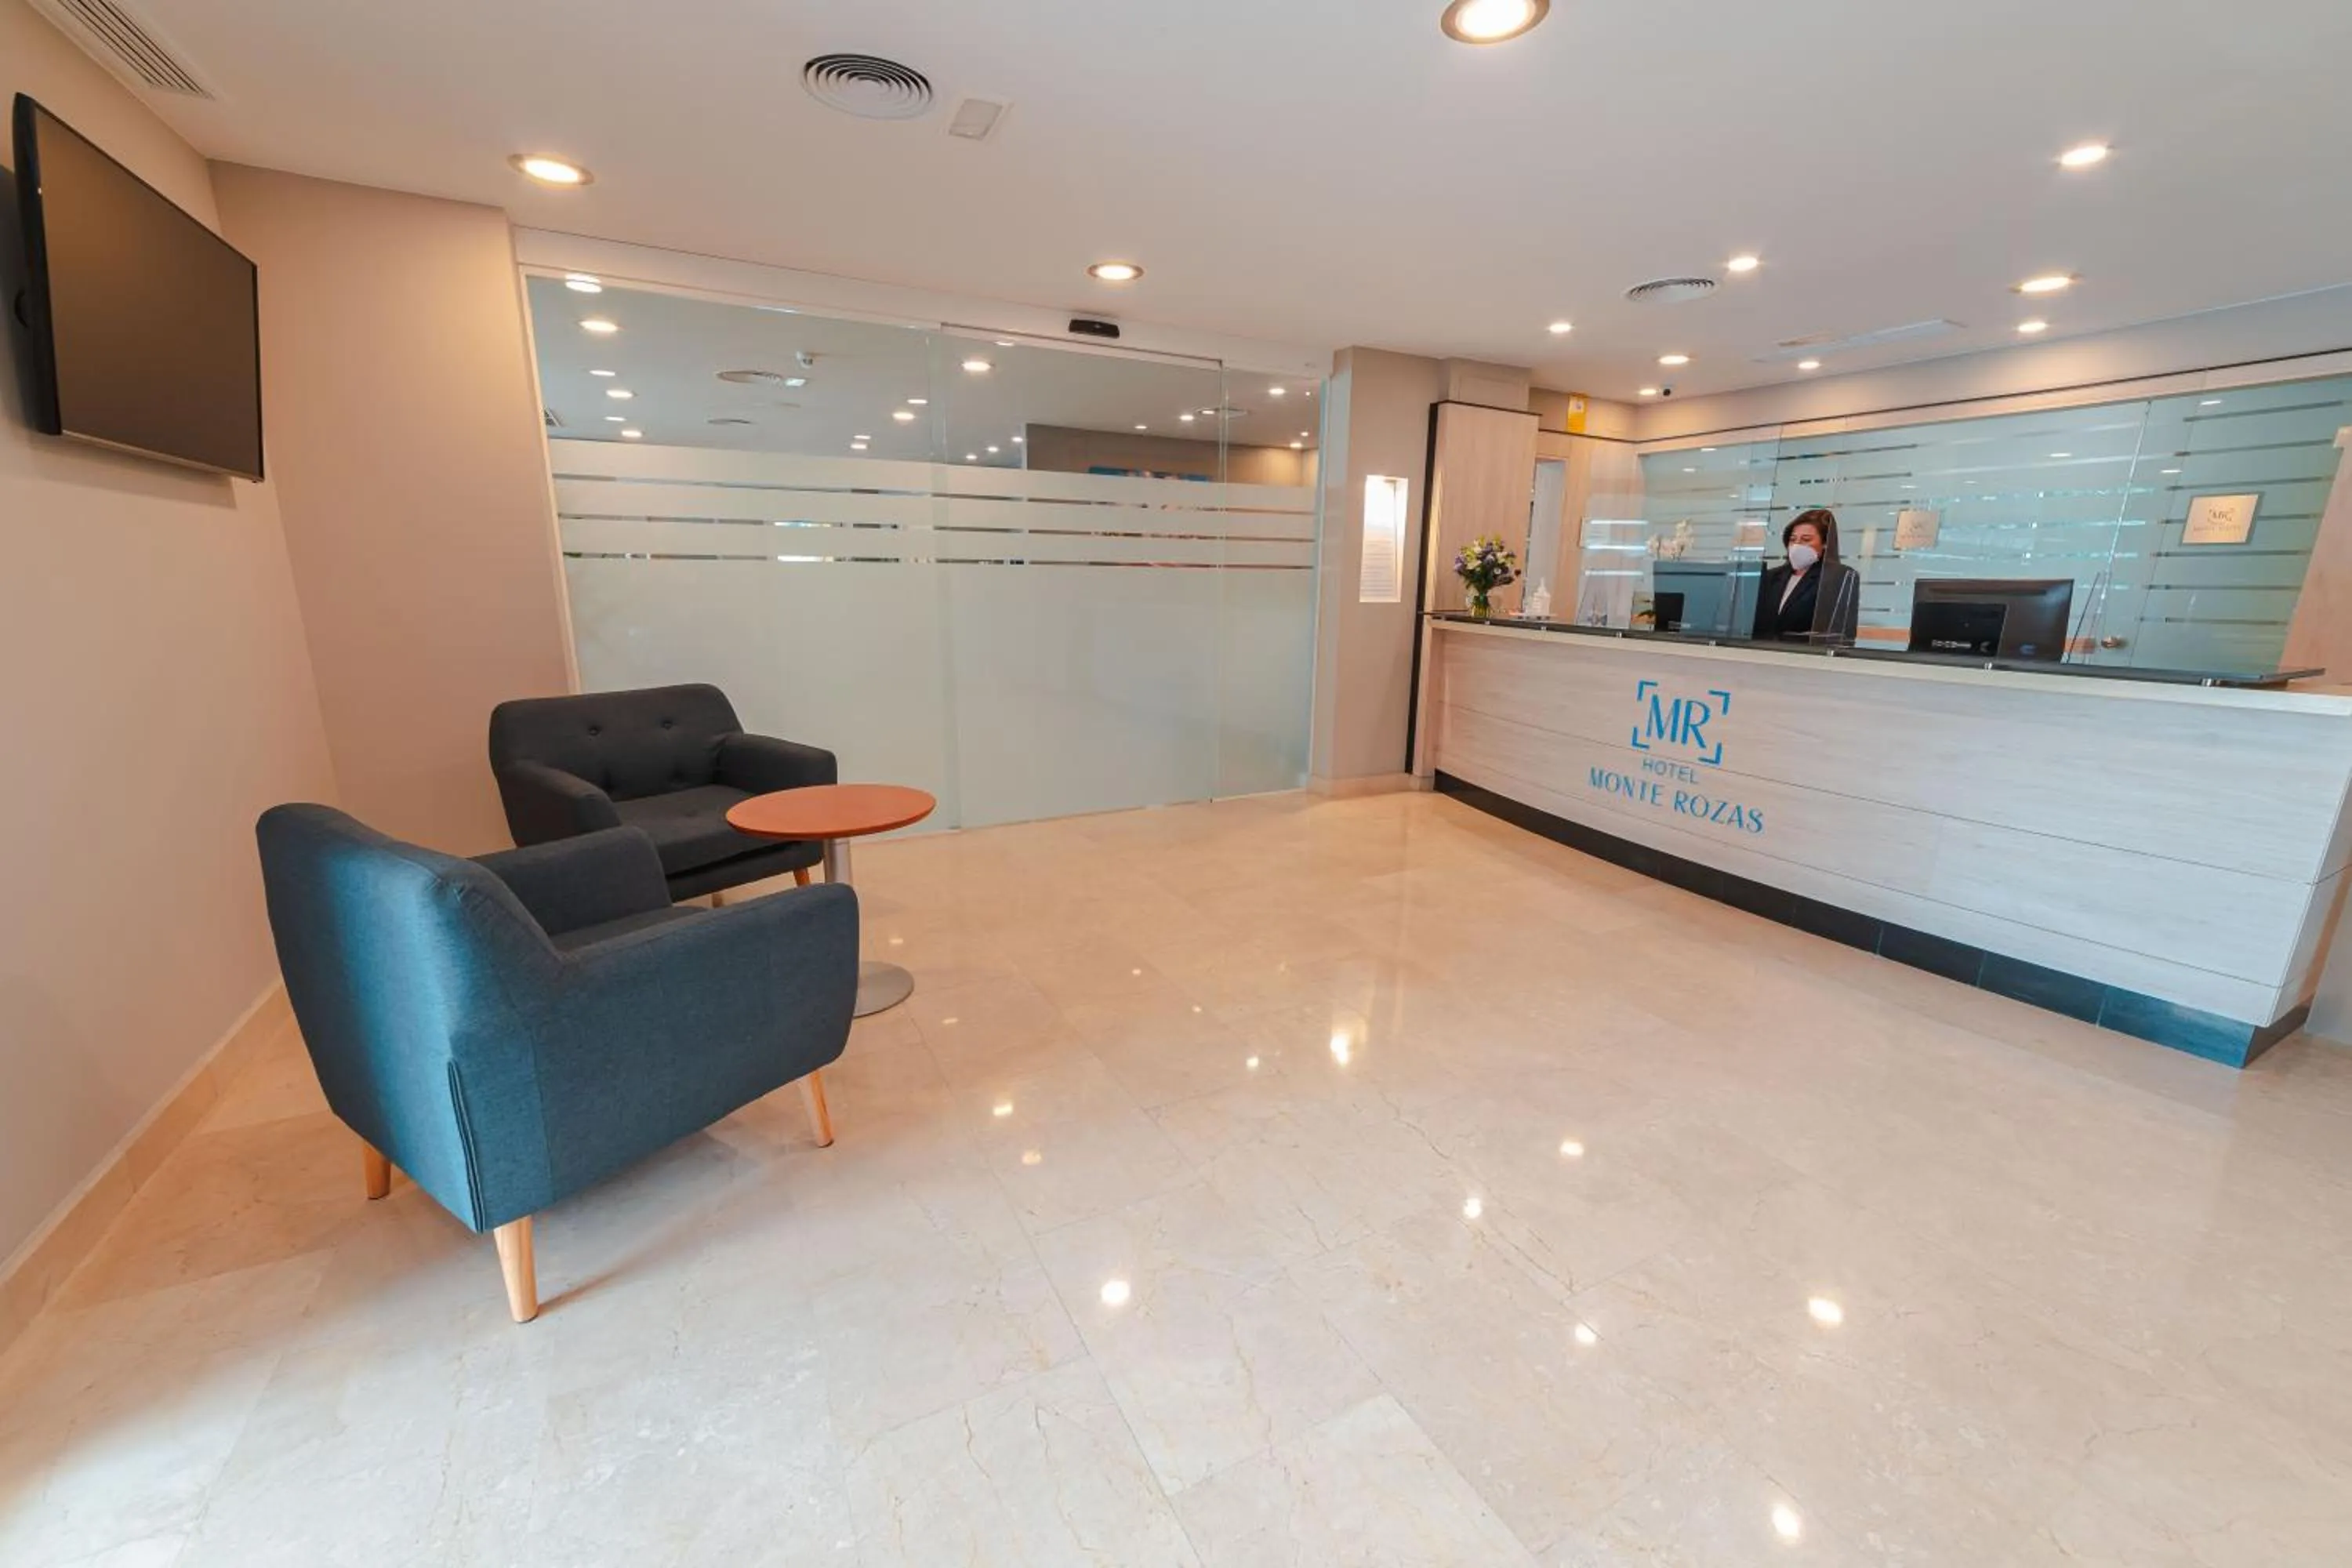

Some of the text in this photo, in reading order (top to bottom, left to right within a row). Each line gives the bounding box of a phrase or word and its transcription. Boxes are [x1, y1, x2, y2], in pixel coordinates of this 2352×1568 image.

[1646, 694, 1711, 749] MR
[1642, 758, 1700, 784] HOTEL
[1588, 767, 1764, 834] MONTE ROZAS
